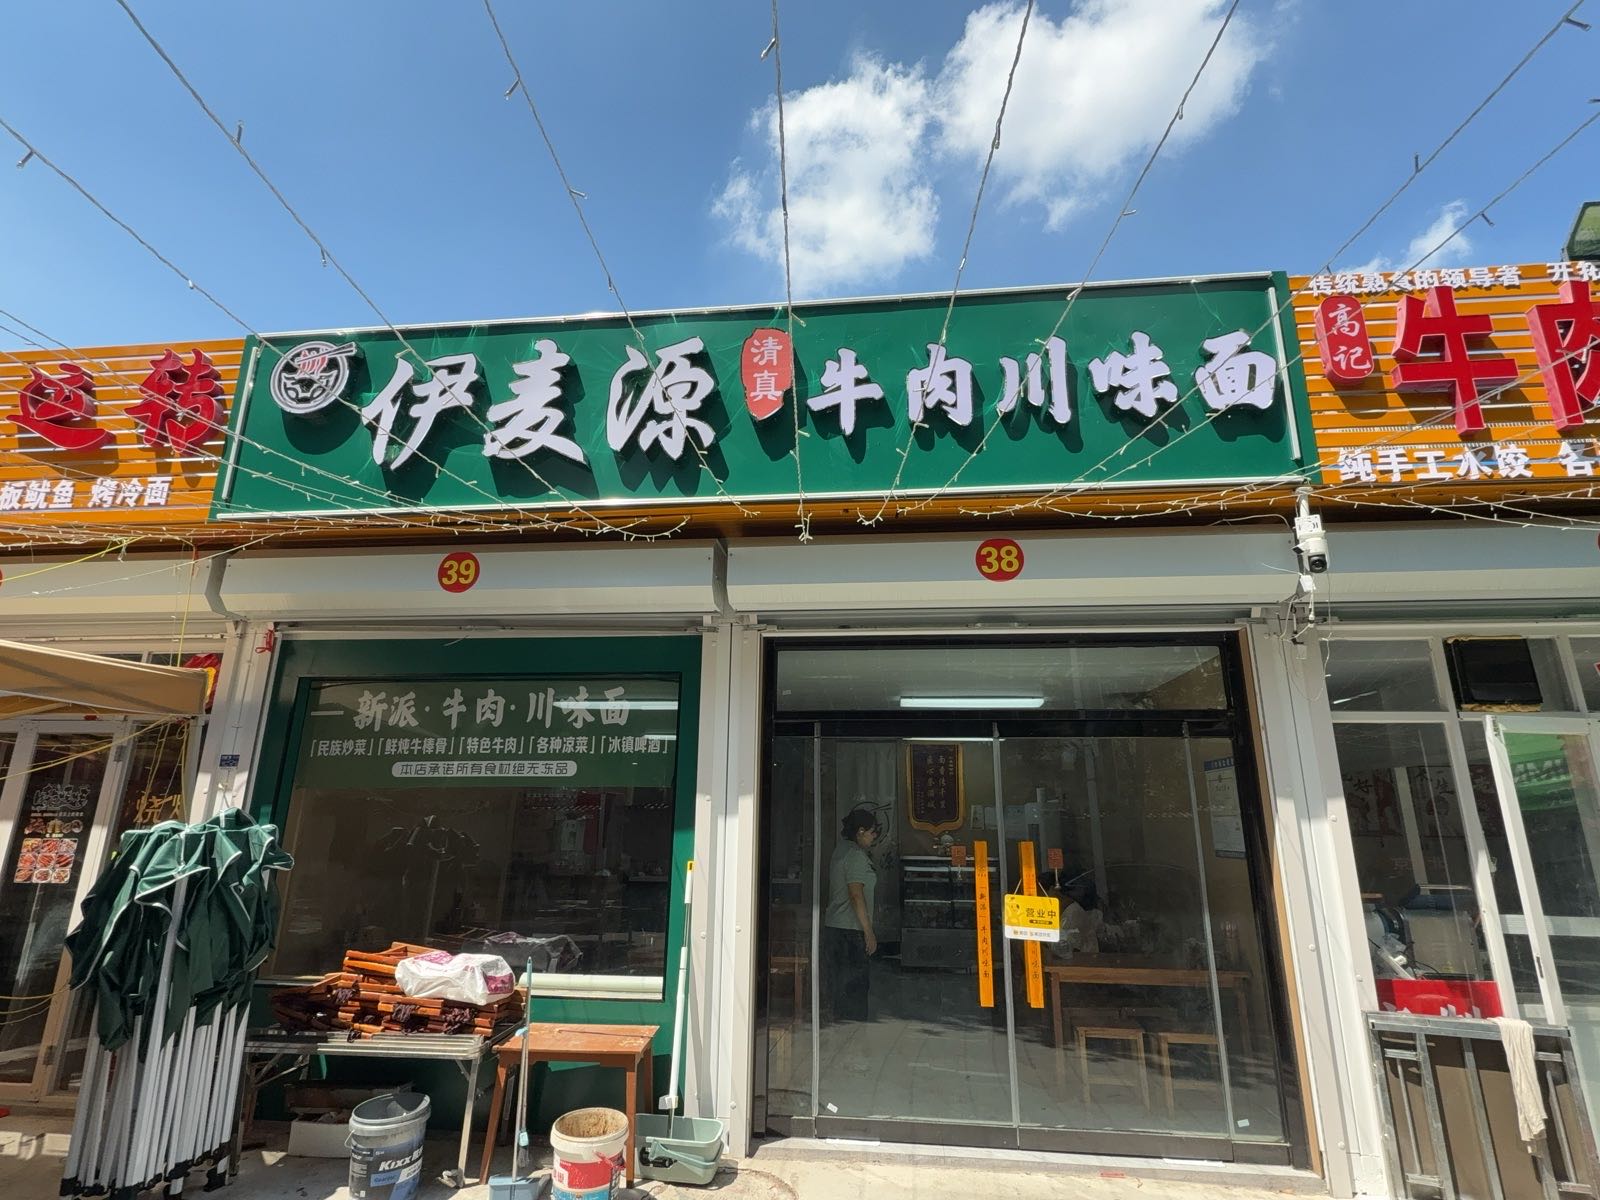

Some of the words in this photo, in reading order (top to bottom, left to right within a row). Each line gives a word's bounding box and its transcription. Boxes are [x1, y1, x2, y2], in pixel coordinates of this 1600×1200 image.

[1328, 303, 1370, 371] 高记
[750, 337, 783, 402] 清真
[806, 330, 1277, 436] 牛肉川味面
[361, 337, 716, 471] 伊麦源
[1339, 443, 1534, 482] 纯手工水饺
[87, 476, 173, 508] 烤冷面
[441, 560, 476, 584] 39
[980, 545, 1020, 575] 38
[399, 761, 568, 777] 本店承诺所有食材绝无冻品
[1025, 907, 1057, 919] 营业中
